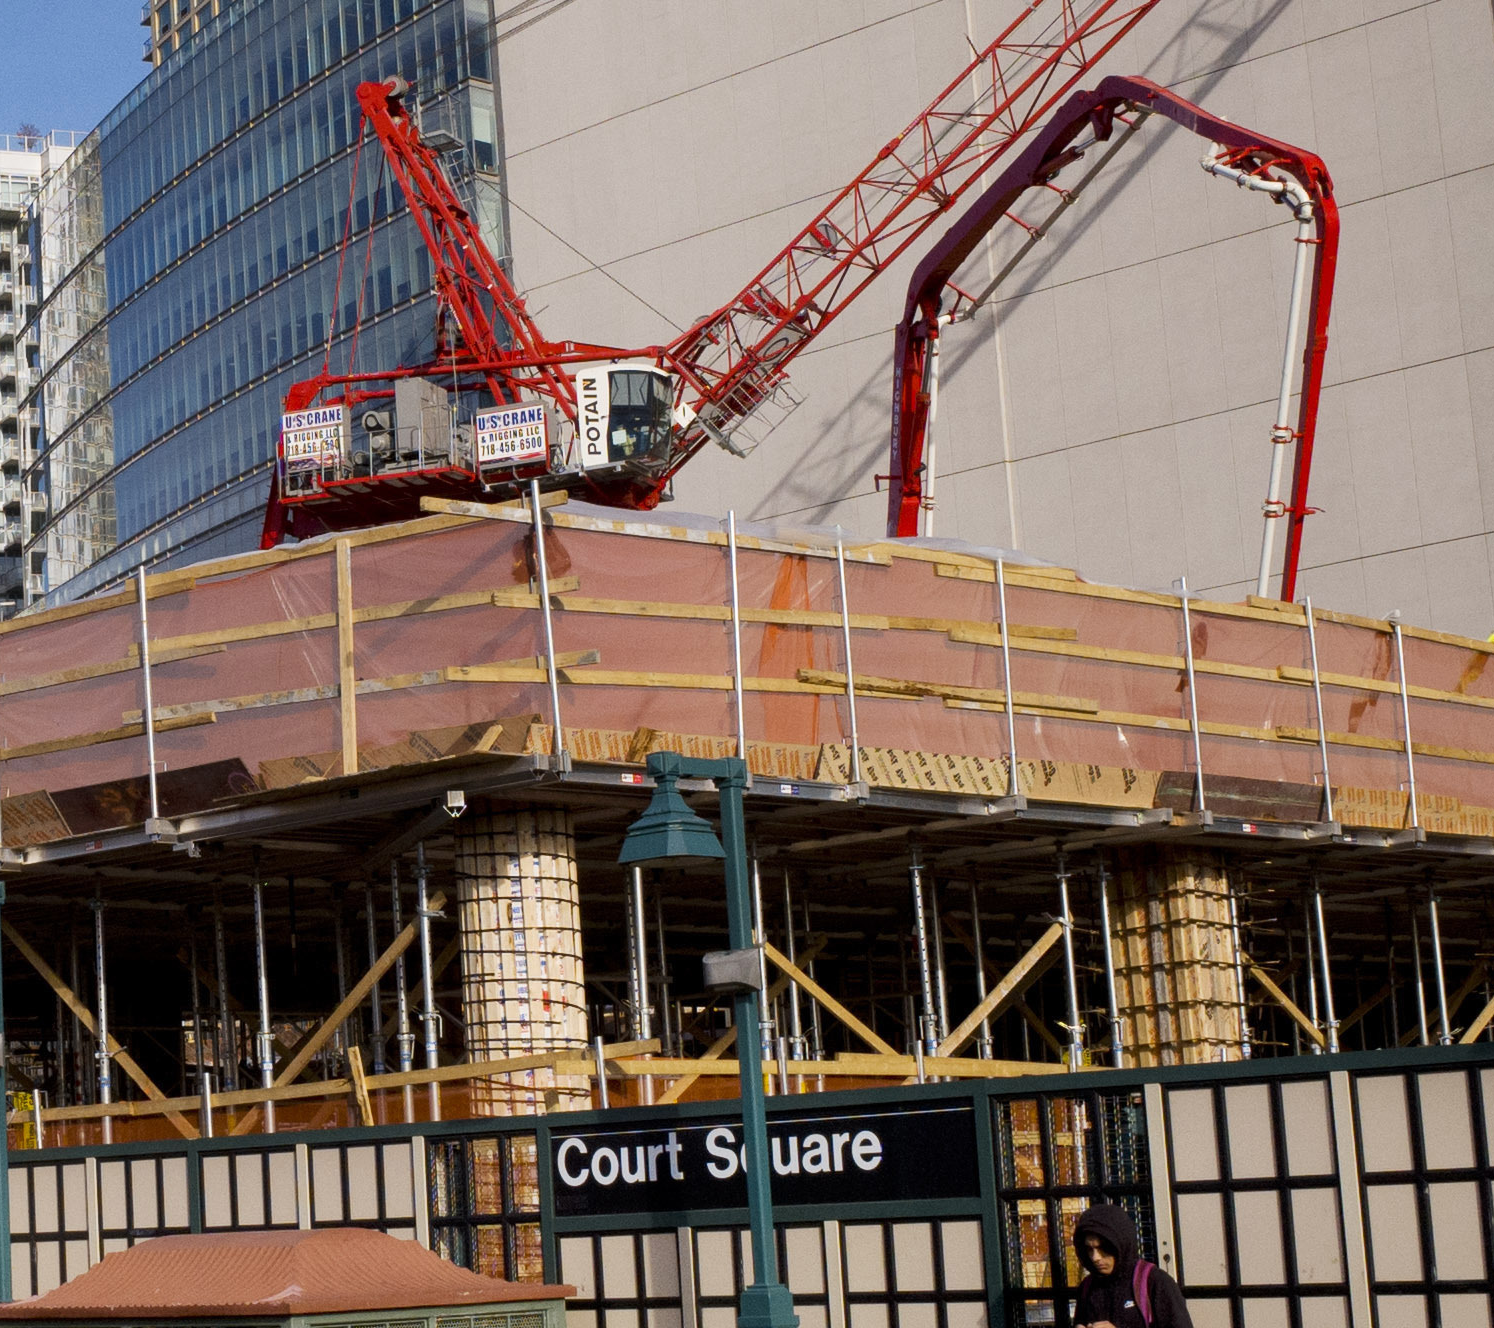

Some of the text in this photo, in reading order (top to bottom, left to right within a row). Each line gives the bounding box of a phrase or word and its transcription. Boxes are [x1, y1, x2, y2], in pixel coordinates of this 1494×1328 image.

[307, 408, 341, 426] CRANE
[503, 407, 543, 426] CRANE
[582, 377, 602, 456] POTAIN
[892, 367, 902, 460] HIGHBURY
[294, 430, 324, 443] RIGGING
[489, 429, 524, 443] RIGGING
[526, 426, 540, 437] LLC
[481, 436, 542, 457] 718-456-6500
[557, 1127, 883, 1187] Court Suare
